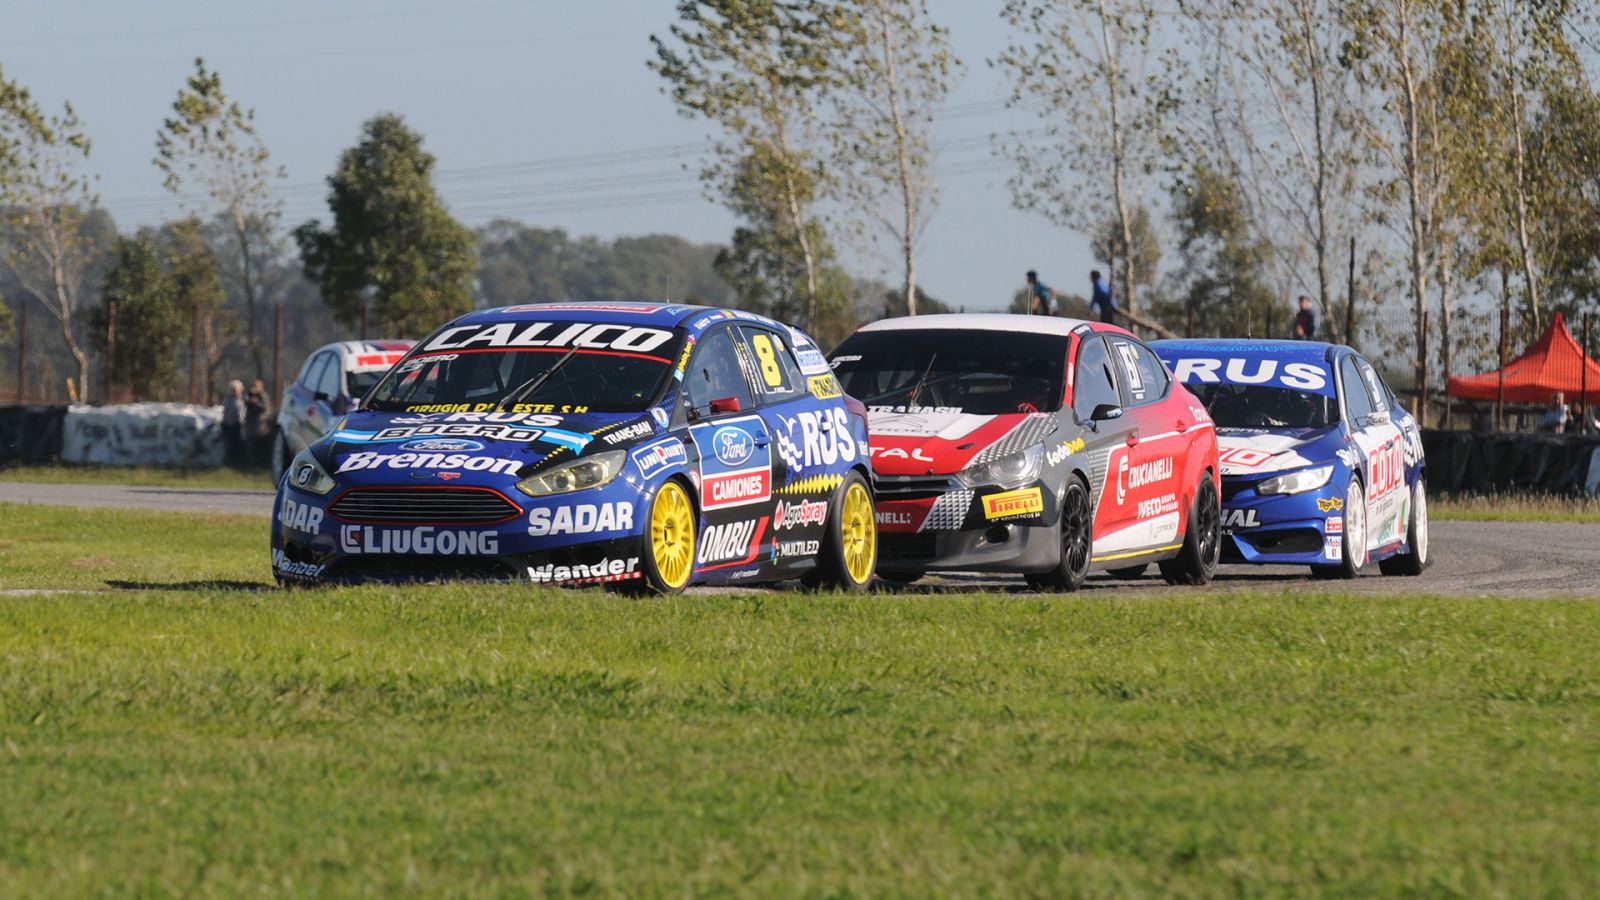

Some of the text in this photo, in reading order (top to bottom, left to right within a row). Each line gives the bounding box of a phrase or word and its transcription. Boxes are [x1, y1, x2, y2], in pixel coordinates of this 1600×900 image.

[424, 322, 673, 352] CALICO
[753, 334, 781, 386] 8
[1173, 358, 1326, 389] RUS
[443, 412, 564, 427] RUS
[512, 403, 555, 413] ESTE
[721, 433, 747, 460] Ford
[799, 406, 856, 467] RUS
[335, 453, 523, 476] Brenson
[1128, 456, 1173, 490] CRUCIANELLI
[1369, 434, 1402, 500] COTO
[712, 475, 762, 501] CAMIONES
[989, 493, 1039, 513] PIRELLI
[528, 501, 633, 536] SADAR
[698, 520, 756, 564] OMBU
[780, 540, 820, 557] MULTILED
